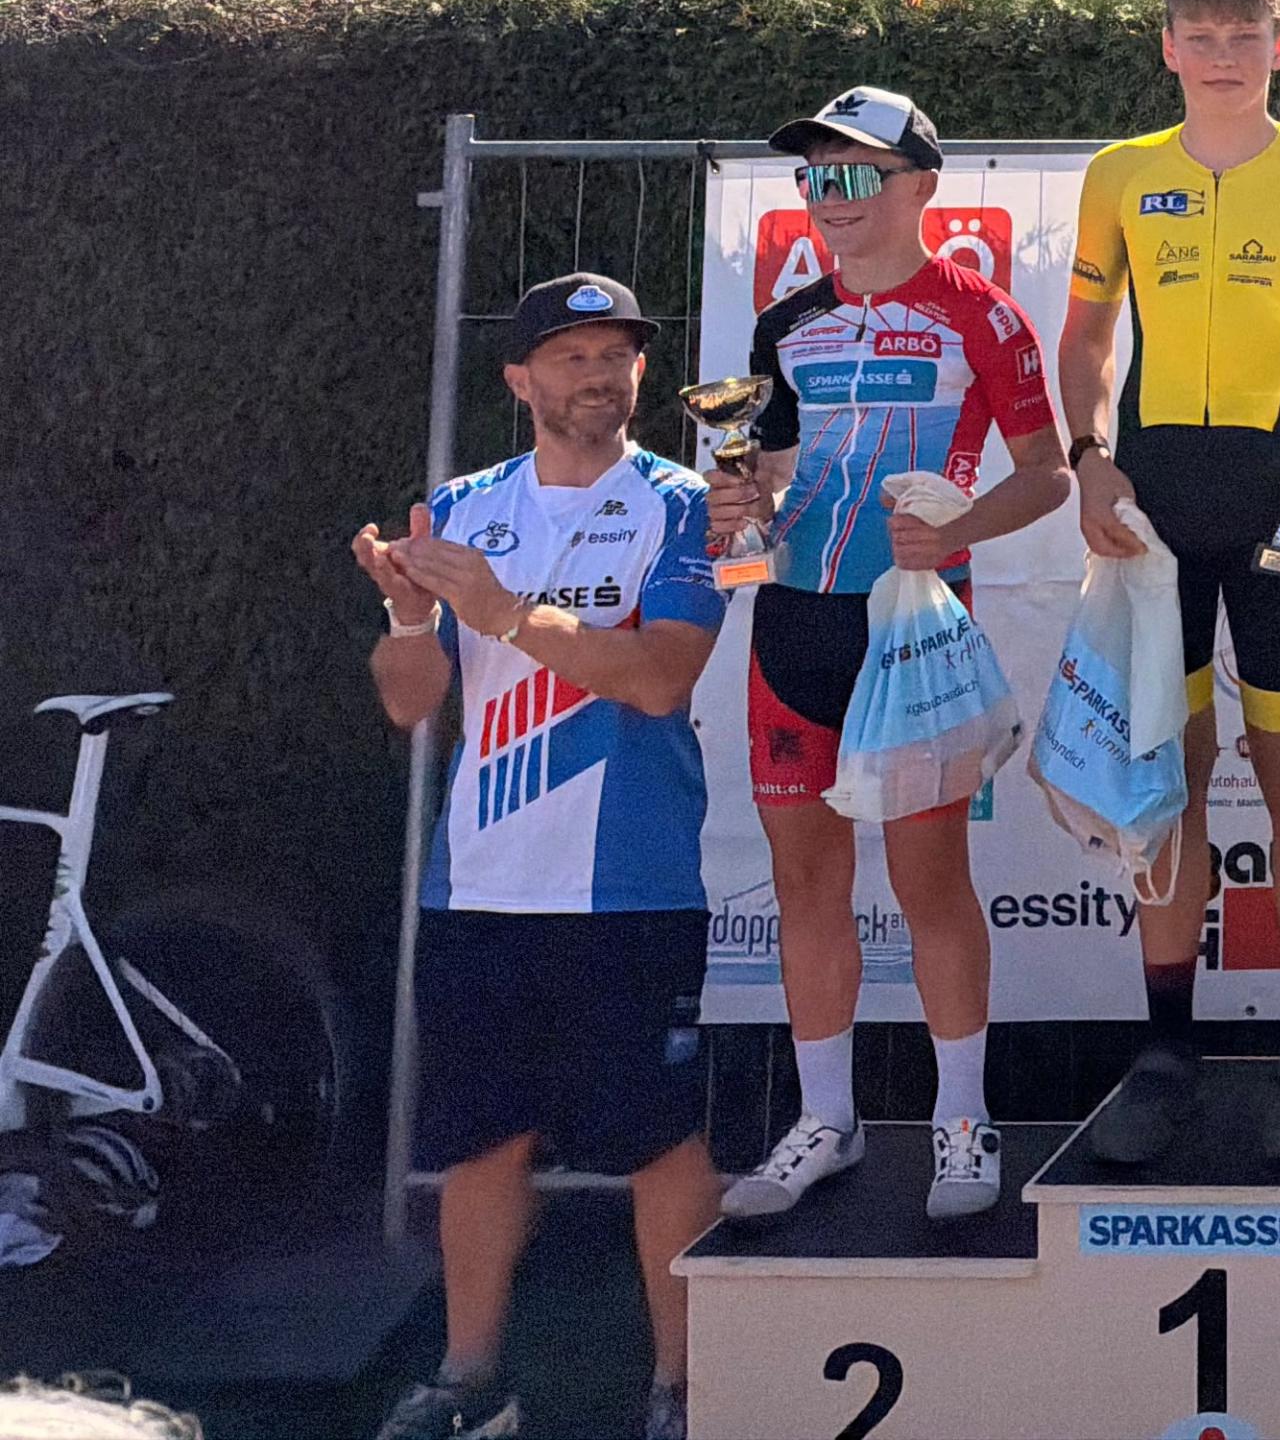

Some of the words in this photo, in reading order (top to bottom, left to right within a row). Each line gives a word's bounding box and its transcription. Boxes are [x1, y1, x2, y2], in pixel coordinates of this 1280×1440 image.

[878, 335, 938, 353] ARBÖ
[990, 880, 1139, 937] essity
[1158, 1267, 1228, 1415] 1
[823, 1341, 904, 1440] 2
